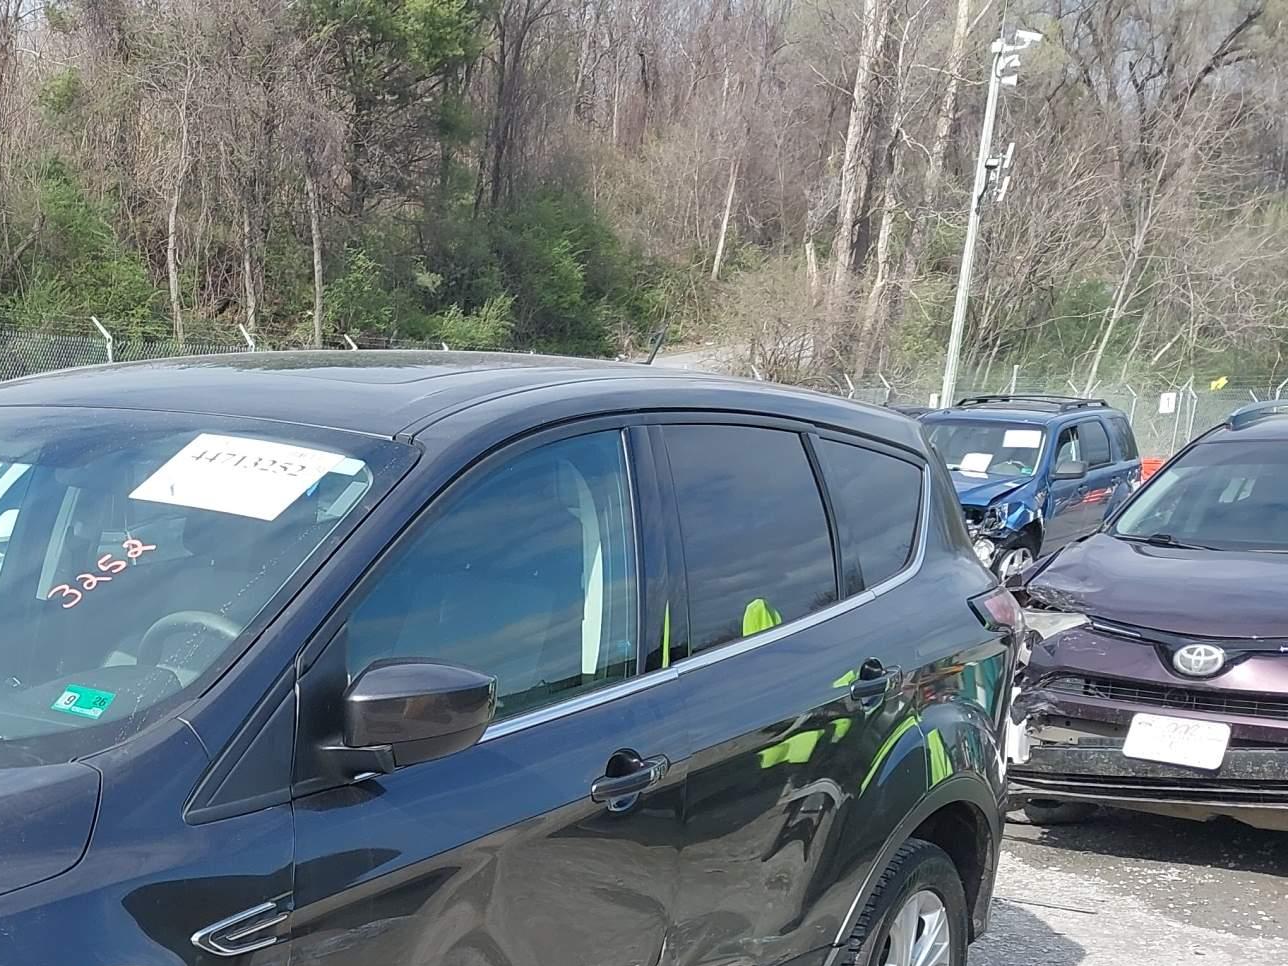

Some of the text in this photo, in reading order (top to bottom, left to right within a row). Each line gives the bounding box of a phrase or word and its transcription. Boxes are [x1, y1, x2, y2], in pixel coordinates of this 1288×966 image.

[191, 450, 307, 477] 44713252
[47, 538, 157, 609] 3252
[64, 695, 108, 707] 9 26
